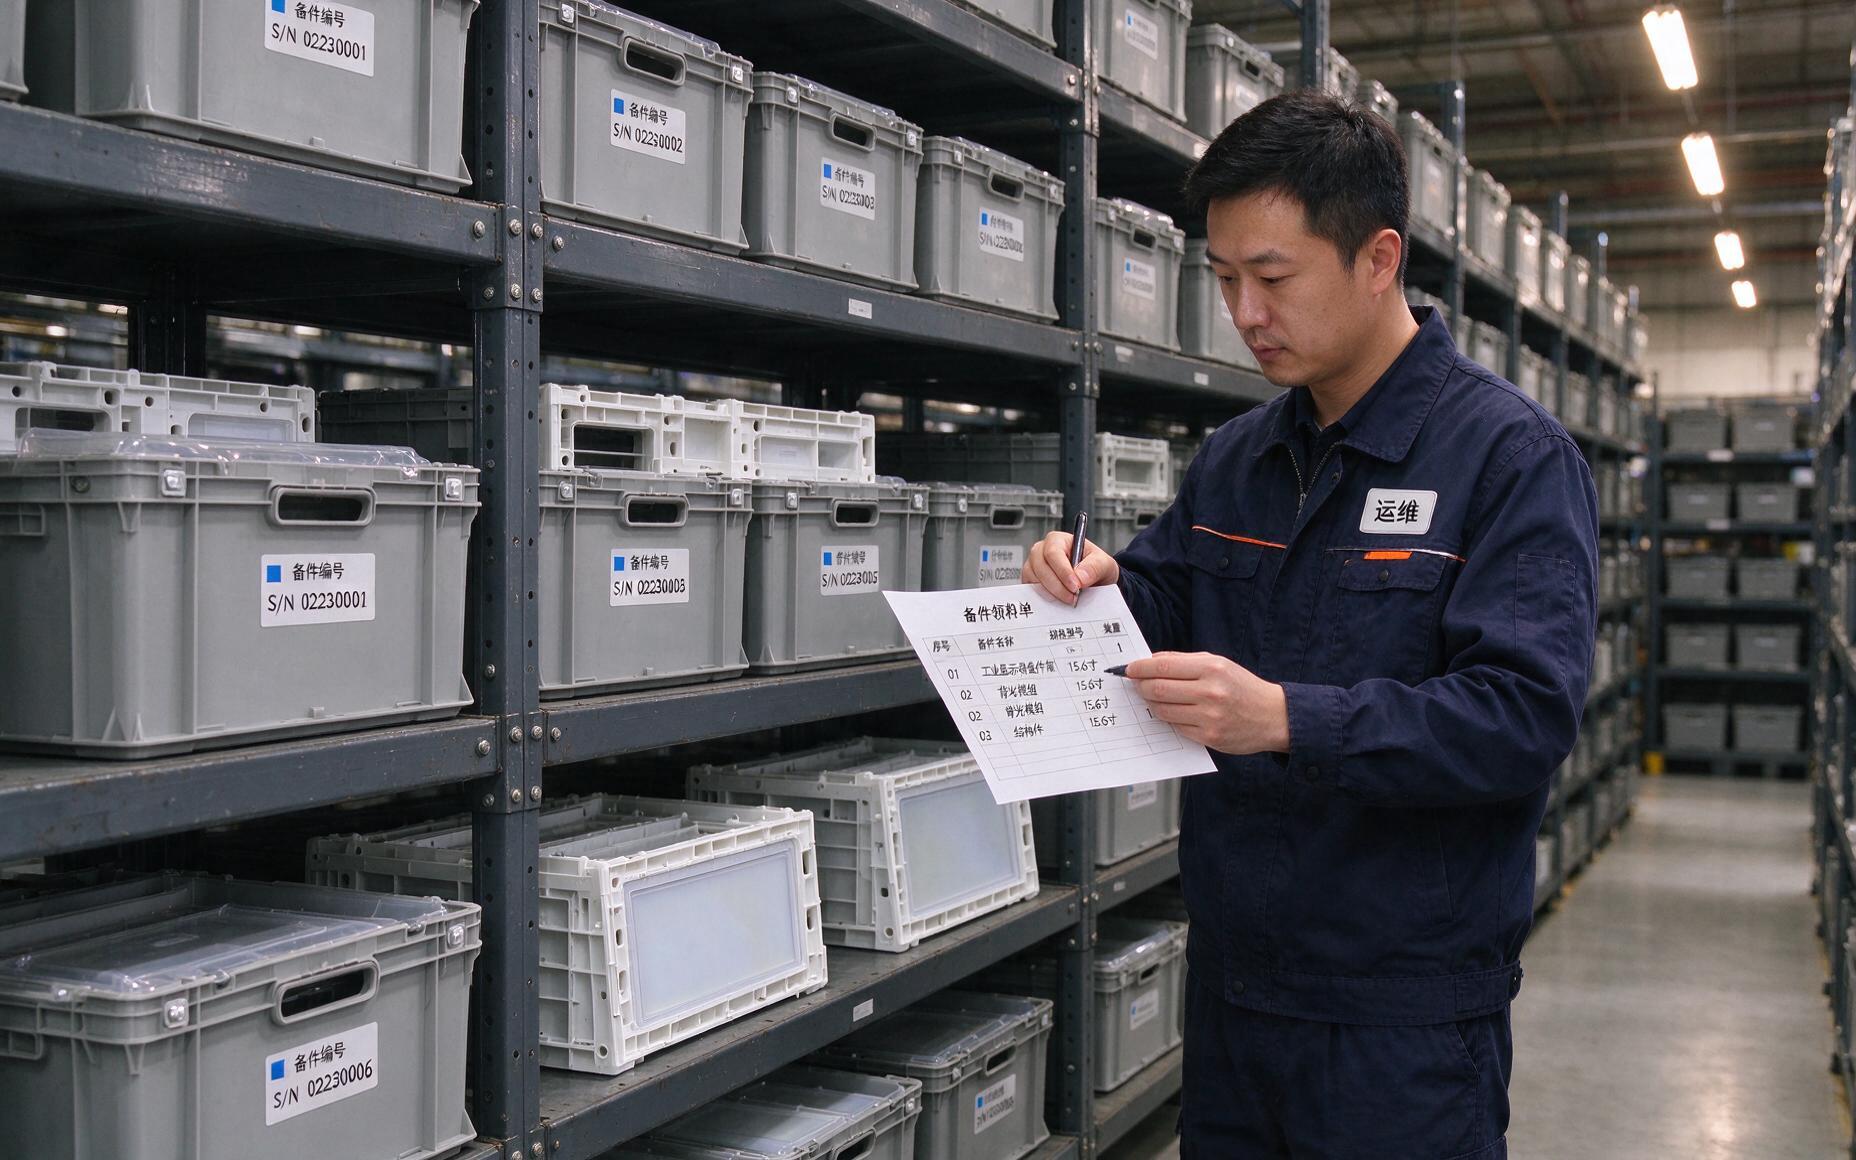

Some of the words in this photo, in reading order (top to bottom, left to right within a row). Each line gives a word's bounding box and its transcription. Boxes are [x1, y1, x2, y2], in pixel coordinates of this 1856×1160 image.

[294, 1, 346, 28] 备件编号
[271, 22, 297, 43] S/N
[303, 30, 366, 61] 02230001
[613, 122, 632, 141] S/N
[822, 184, 837, 203] S/N
[1374, 499, 1420, 524] 运维
[292, 561, 345, 581] 备件编号
[821, 572, 838, 588] S/N
[613, 580, 633, 596] S/N
[267, 593, 295, 616] S/N
[300, 590, 367, 611] 02230001
[947, 668, 960, 680] 01
[960, 689, 973, 701] 02
[968, 710, 983, 722] 02
[979, 730, 992, 741] 03
[294, 1041, 346, 1073] 备件编号
[272, 1085, 299, 1110] S/N
[306, 1058, 373, 1098] 02230006
